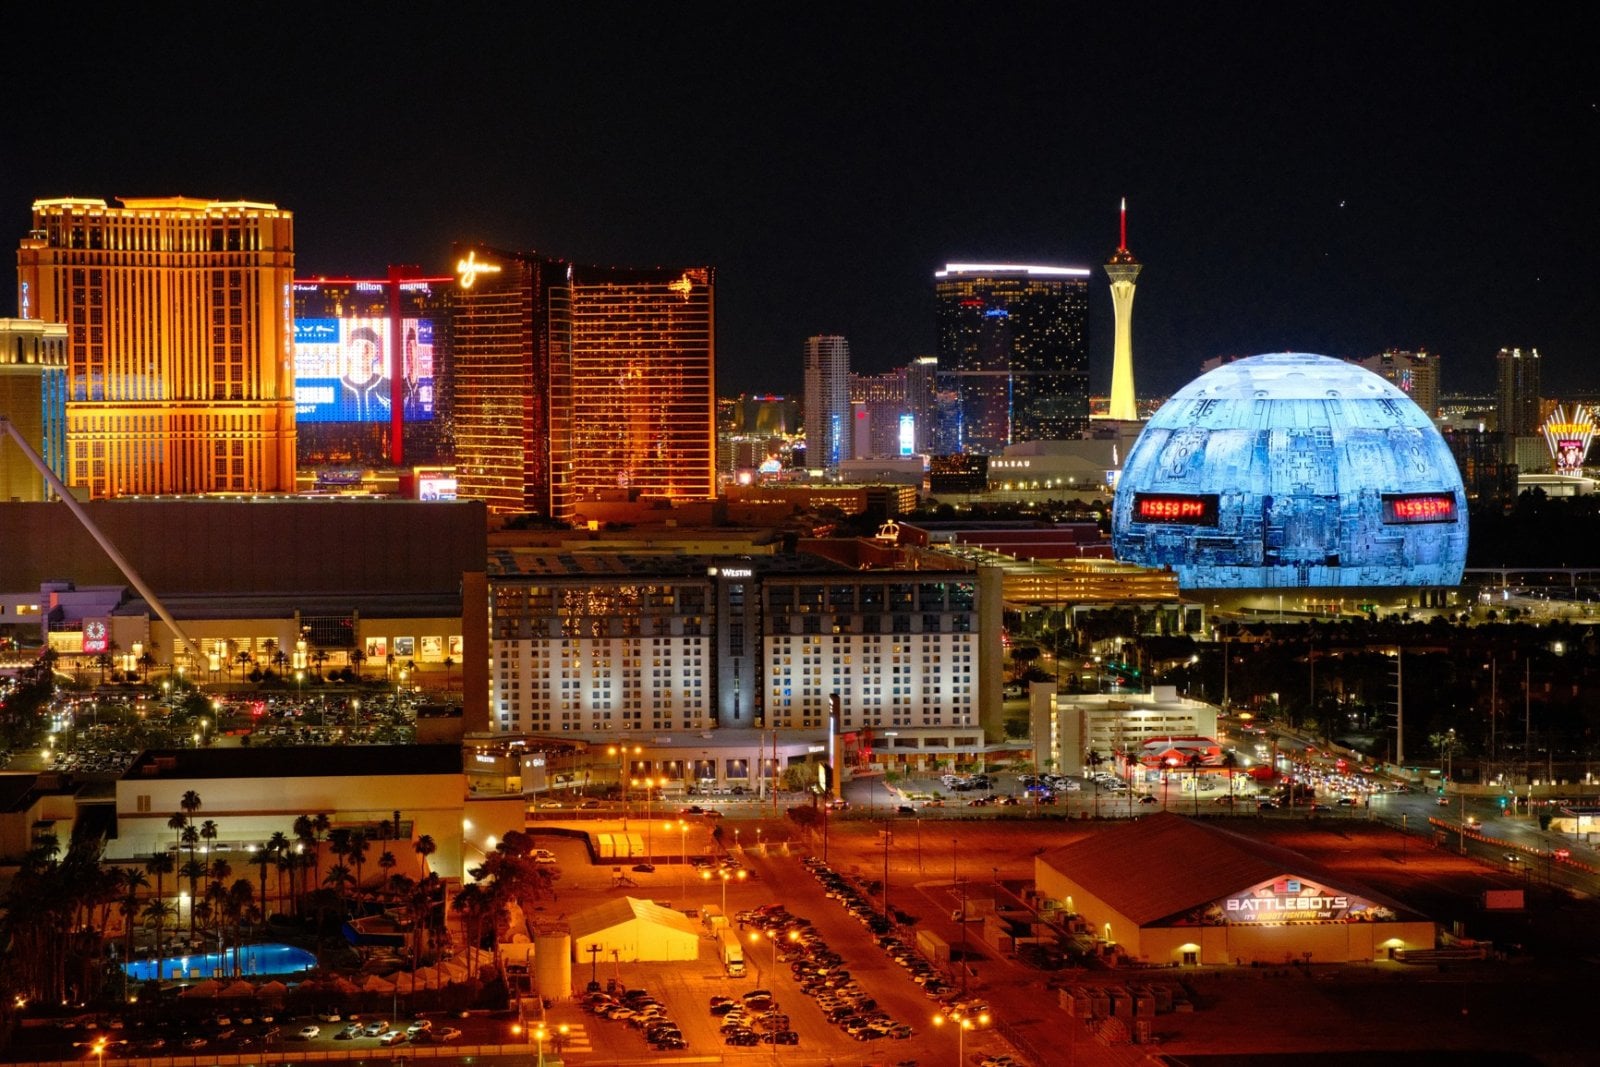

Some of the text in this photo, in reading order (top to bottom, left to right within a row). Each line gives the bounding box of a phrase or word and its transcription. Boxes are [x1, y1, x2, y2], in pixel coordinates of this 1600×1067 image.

[356, 281, 382, 291] Hilton
[1549, 424, 1592, 433] WESTGATE
[1182, 503, 1202, 516] PM
[1438, 501, 1451, 514] PM
[1226, 896, 1348, 911] BATTLEBOTS
